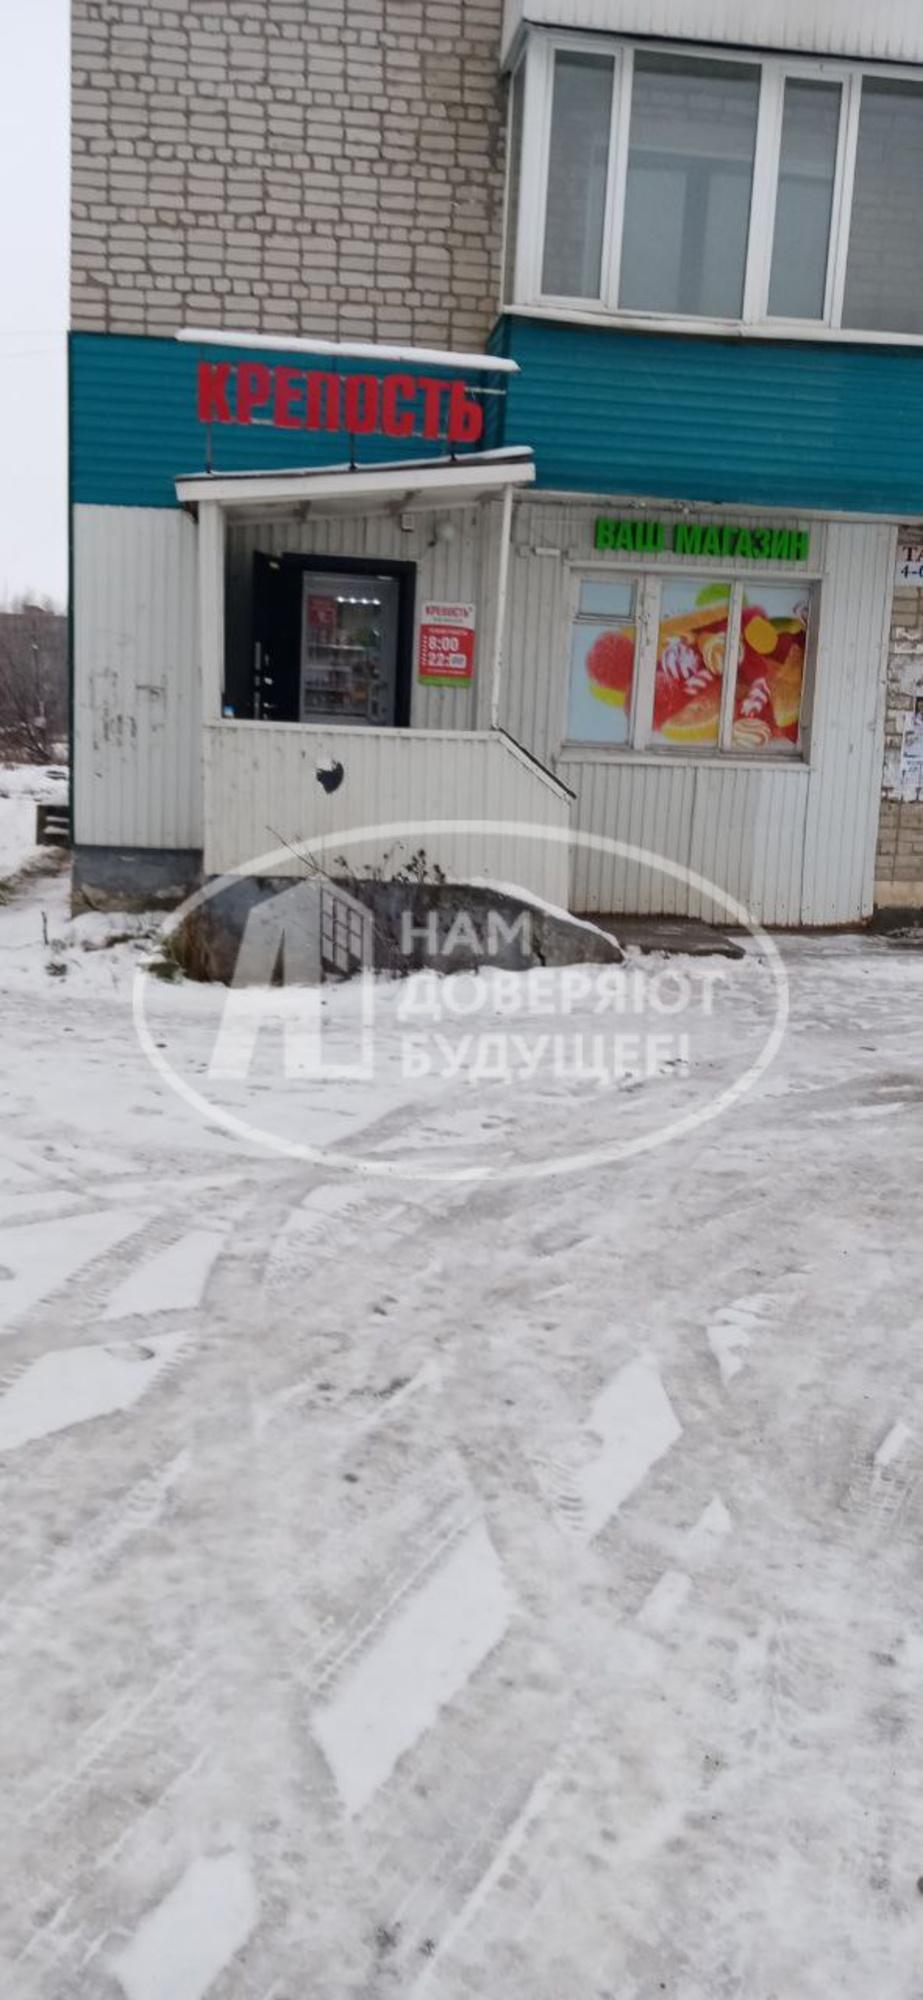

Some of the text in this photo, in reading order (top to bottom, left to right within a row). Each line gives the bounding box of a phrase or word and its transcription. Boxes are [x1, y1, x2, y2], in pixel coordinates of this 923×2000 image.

[196, 361, 484, 443] КРЕПОСТЬ
[595, 517, 809, 562] ВАШ МАГАЗИН
[428, 636, 459, 652] 8:00
